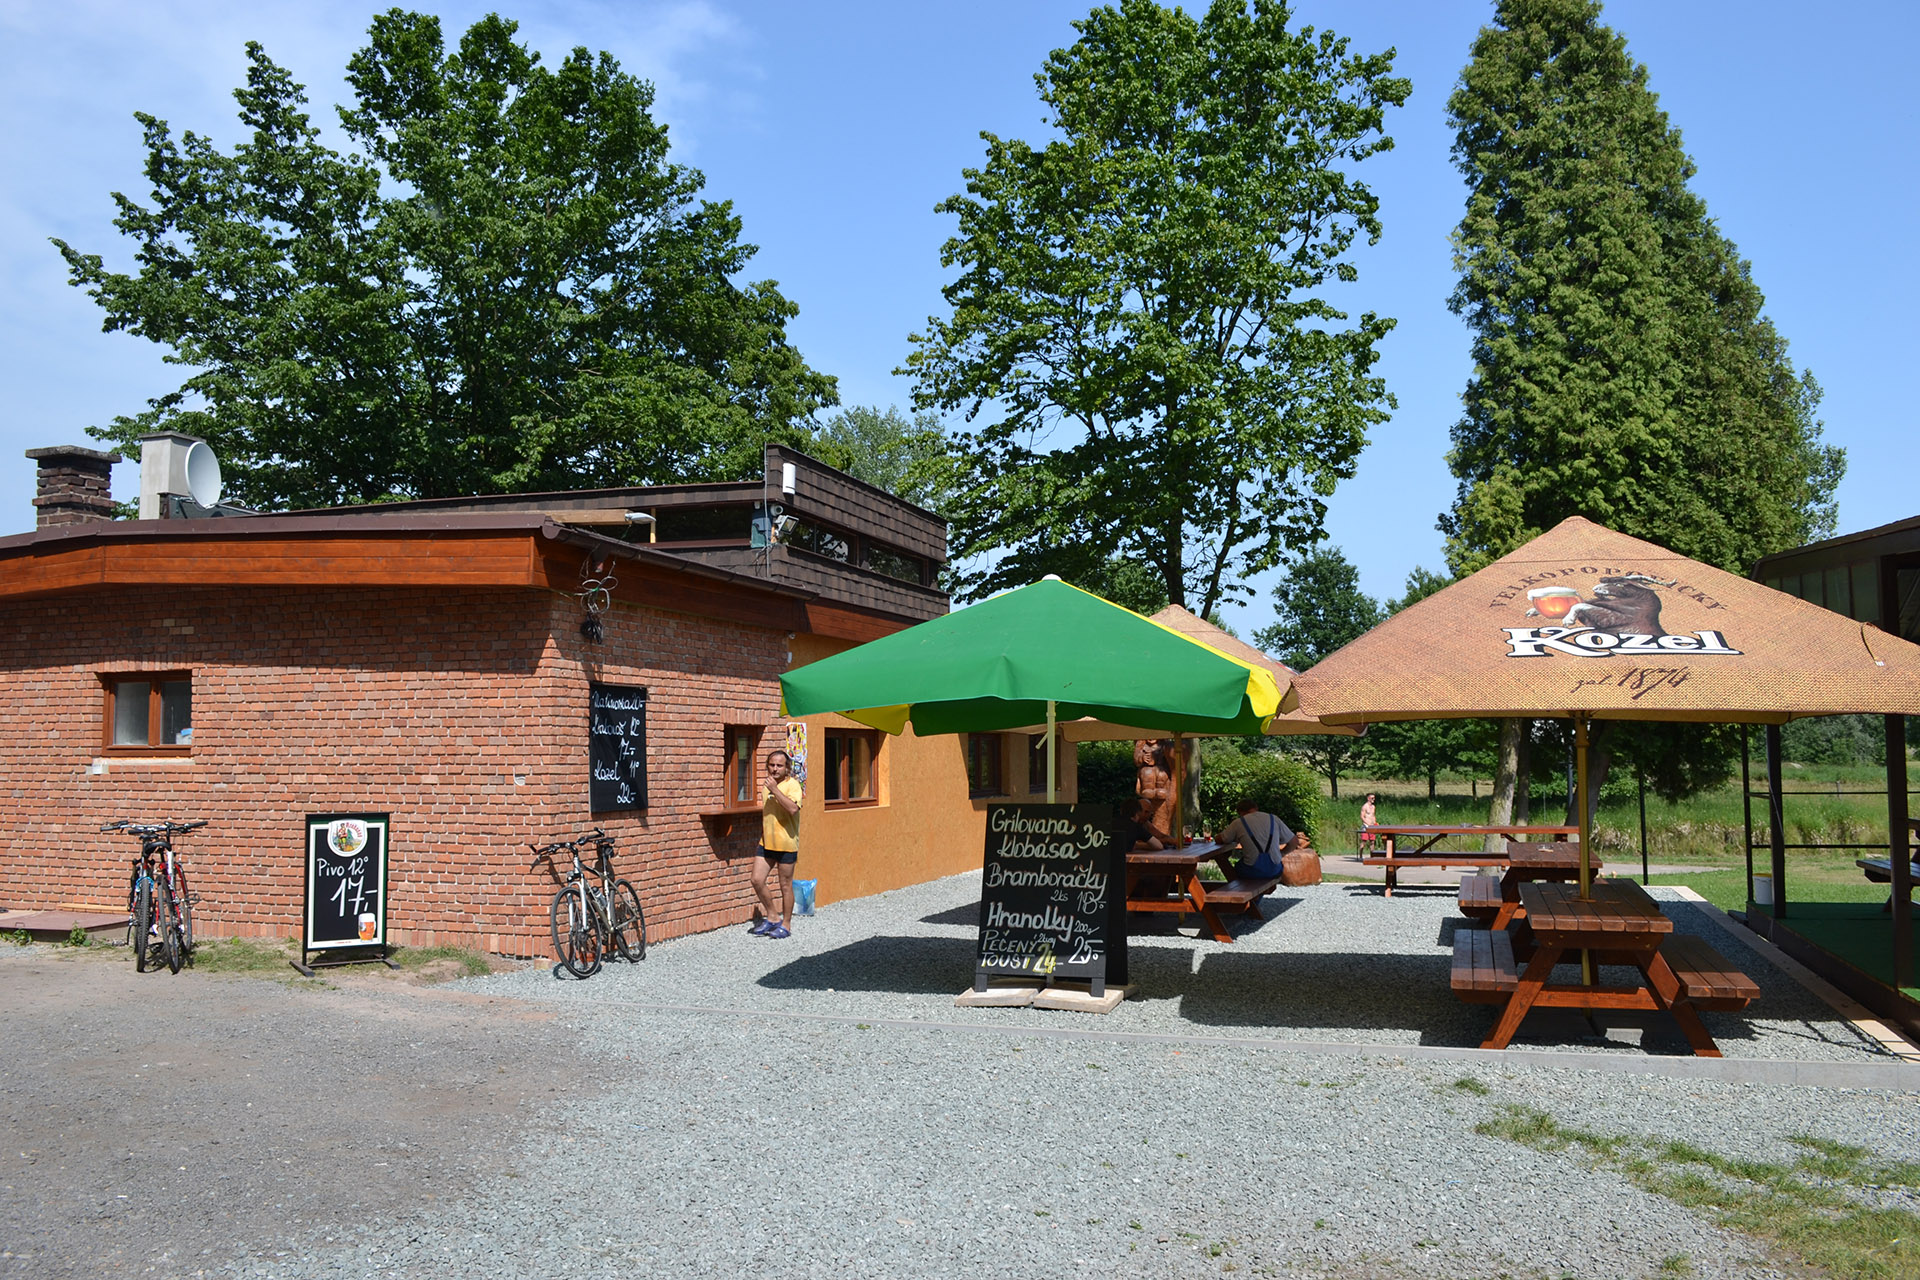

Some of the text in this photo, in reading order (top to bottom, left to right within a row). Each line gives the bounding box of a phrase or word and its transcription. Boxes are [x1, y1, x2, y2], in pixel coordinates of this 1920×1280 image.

[1501, 626, 1744, 657] Kozel
[1617, 666, 1690, 700] 1874
[594, 760, 621, 781] Kozel
[991, 804, 1077, 835] Grilovaná
[316, 857, 345, 877] Pivo
[985, 860, 1108, 901] Bramboráčky
[986, 901, 1075, 943] Hranolky
[981, 952, 1036, 970] TOUST
